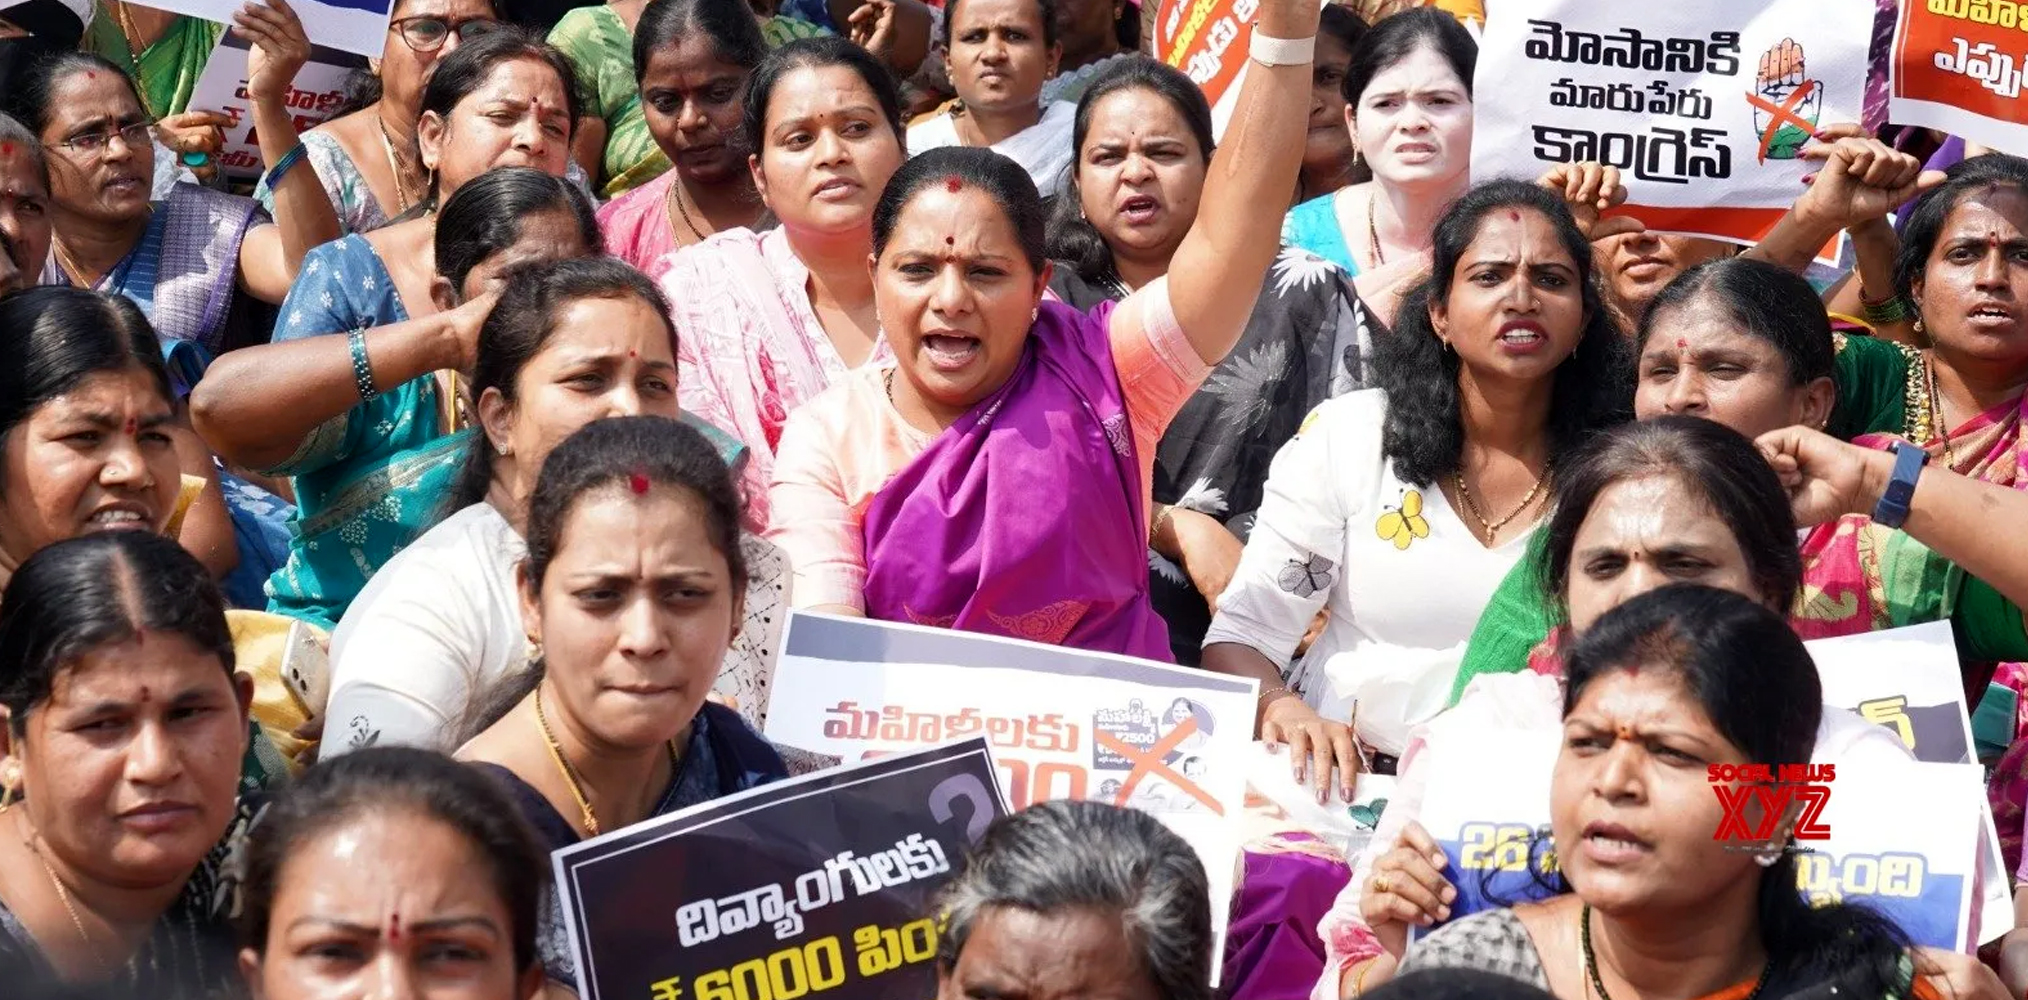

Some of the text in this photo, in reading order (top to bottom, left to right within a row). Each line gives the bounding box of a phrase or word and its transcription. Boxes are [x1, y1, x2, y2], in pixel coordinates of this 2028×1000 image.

[1525, 19, 1741, 76] మోసానికి
[1934, 37, 2028, 98] ఎప్పు
[823, 702, 1079, 753] మహిళలకు
[1459, 823, 1530, 872] 26
